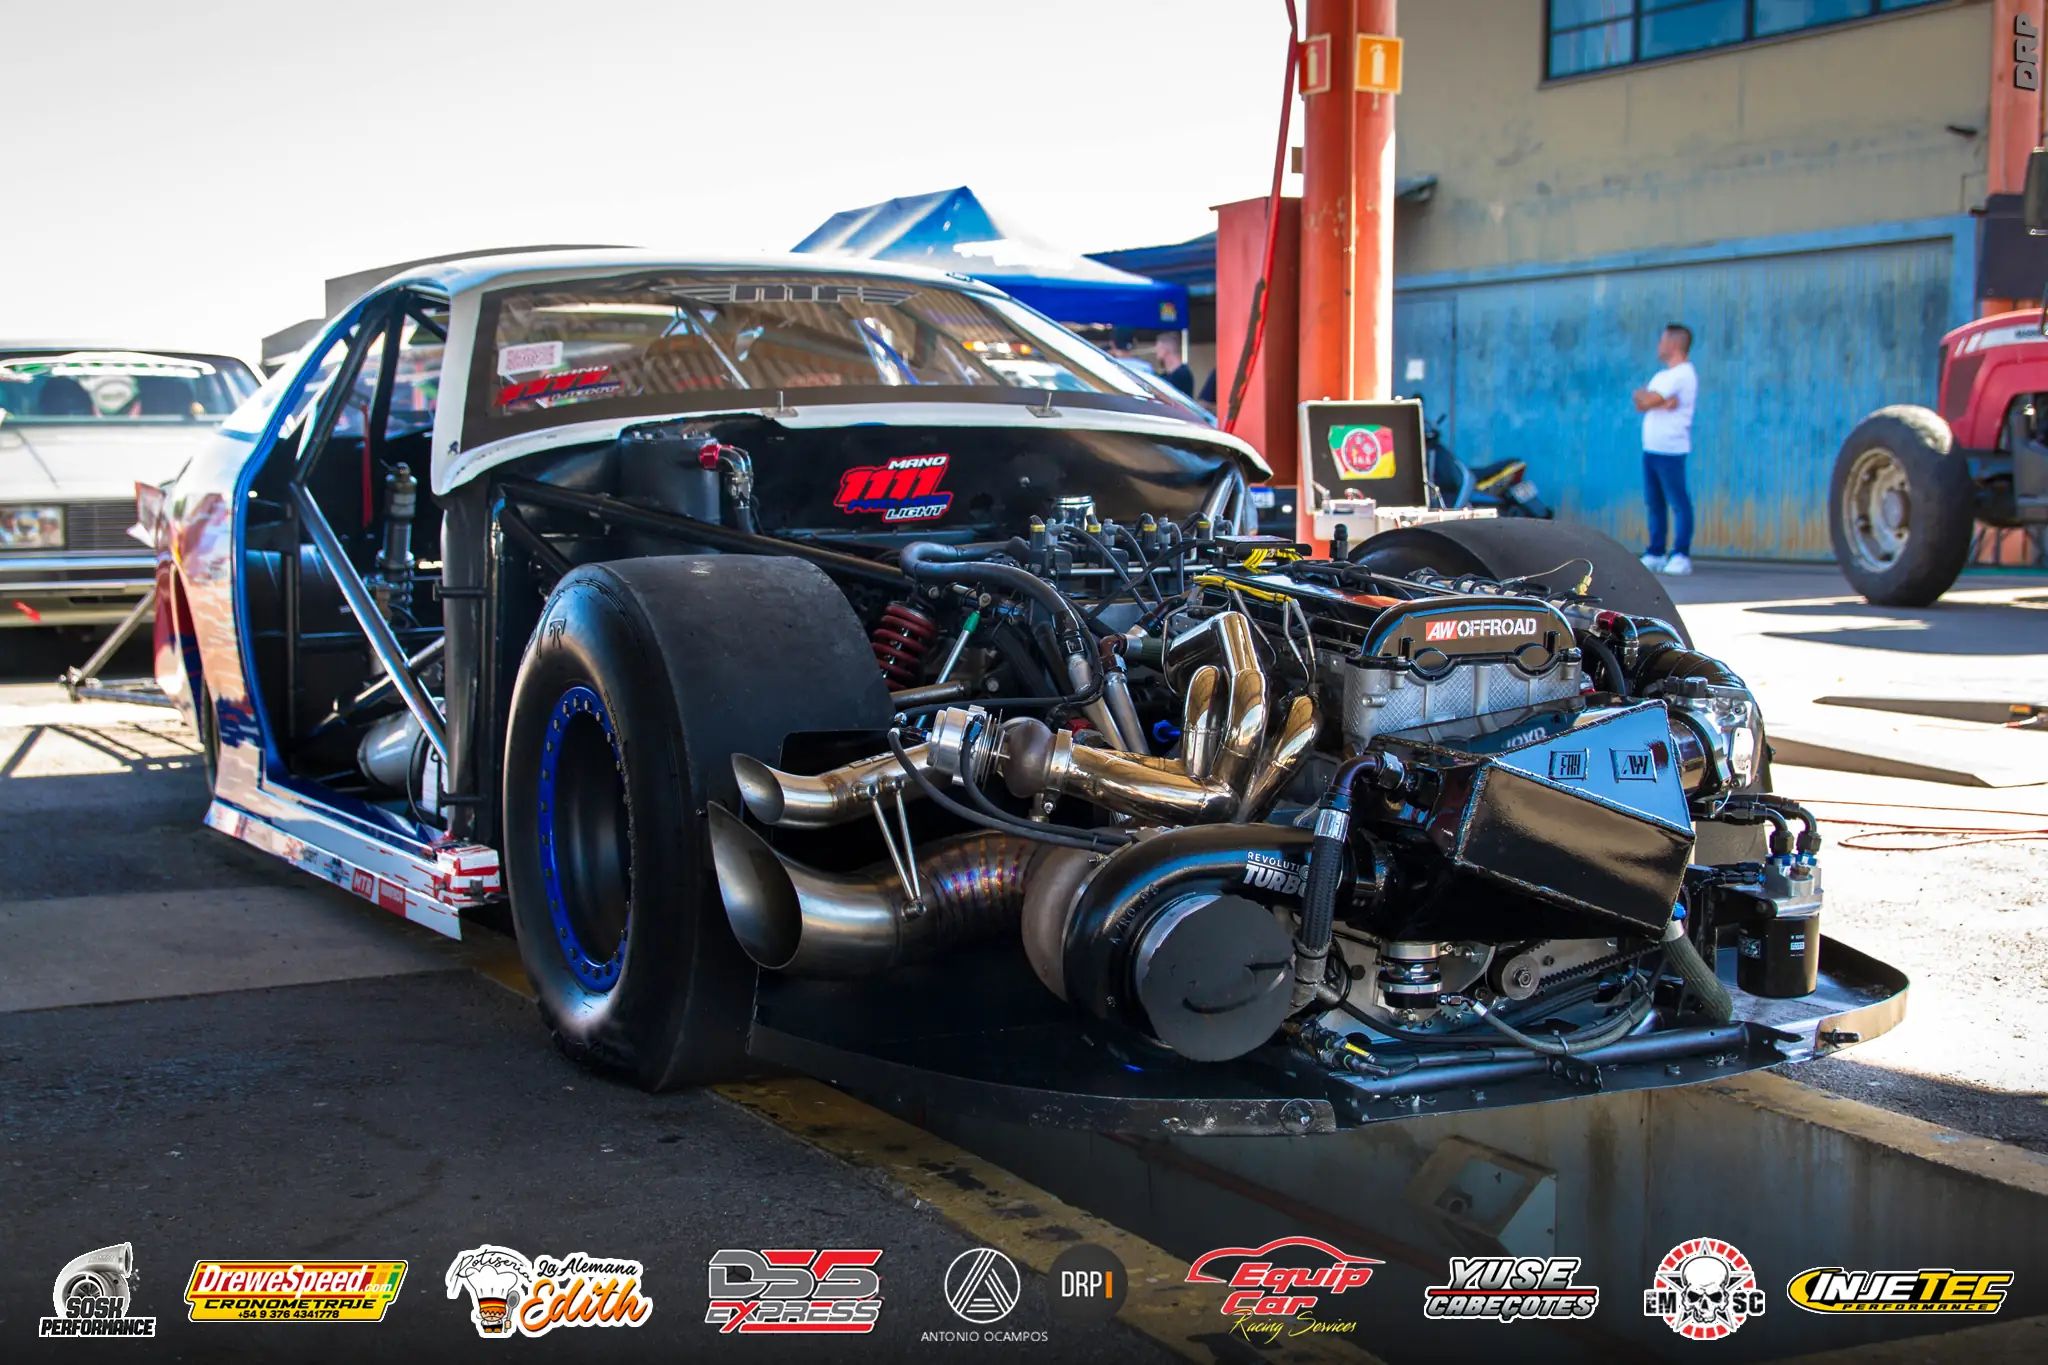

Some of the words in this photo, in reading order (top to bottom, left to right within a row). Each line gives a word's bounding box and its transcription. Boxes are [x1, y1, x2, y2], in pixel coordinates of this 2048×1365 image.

[888, 456, 947, 470] MANO
[839, 466, 943, 503] 1111
[885, 504, 947, 520] LIGHT
[1427, 621, 1457, 640] AW
[1457, 618, 1537, 637] OFFROAD
